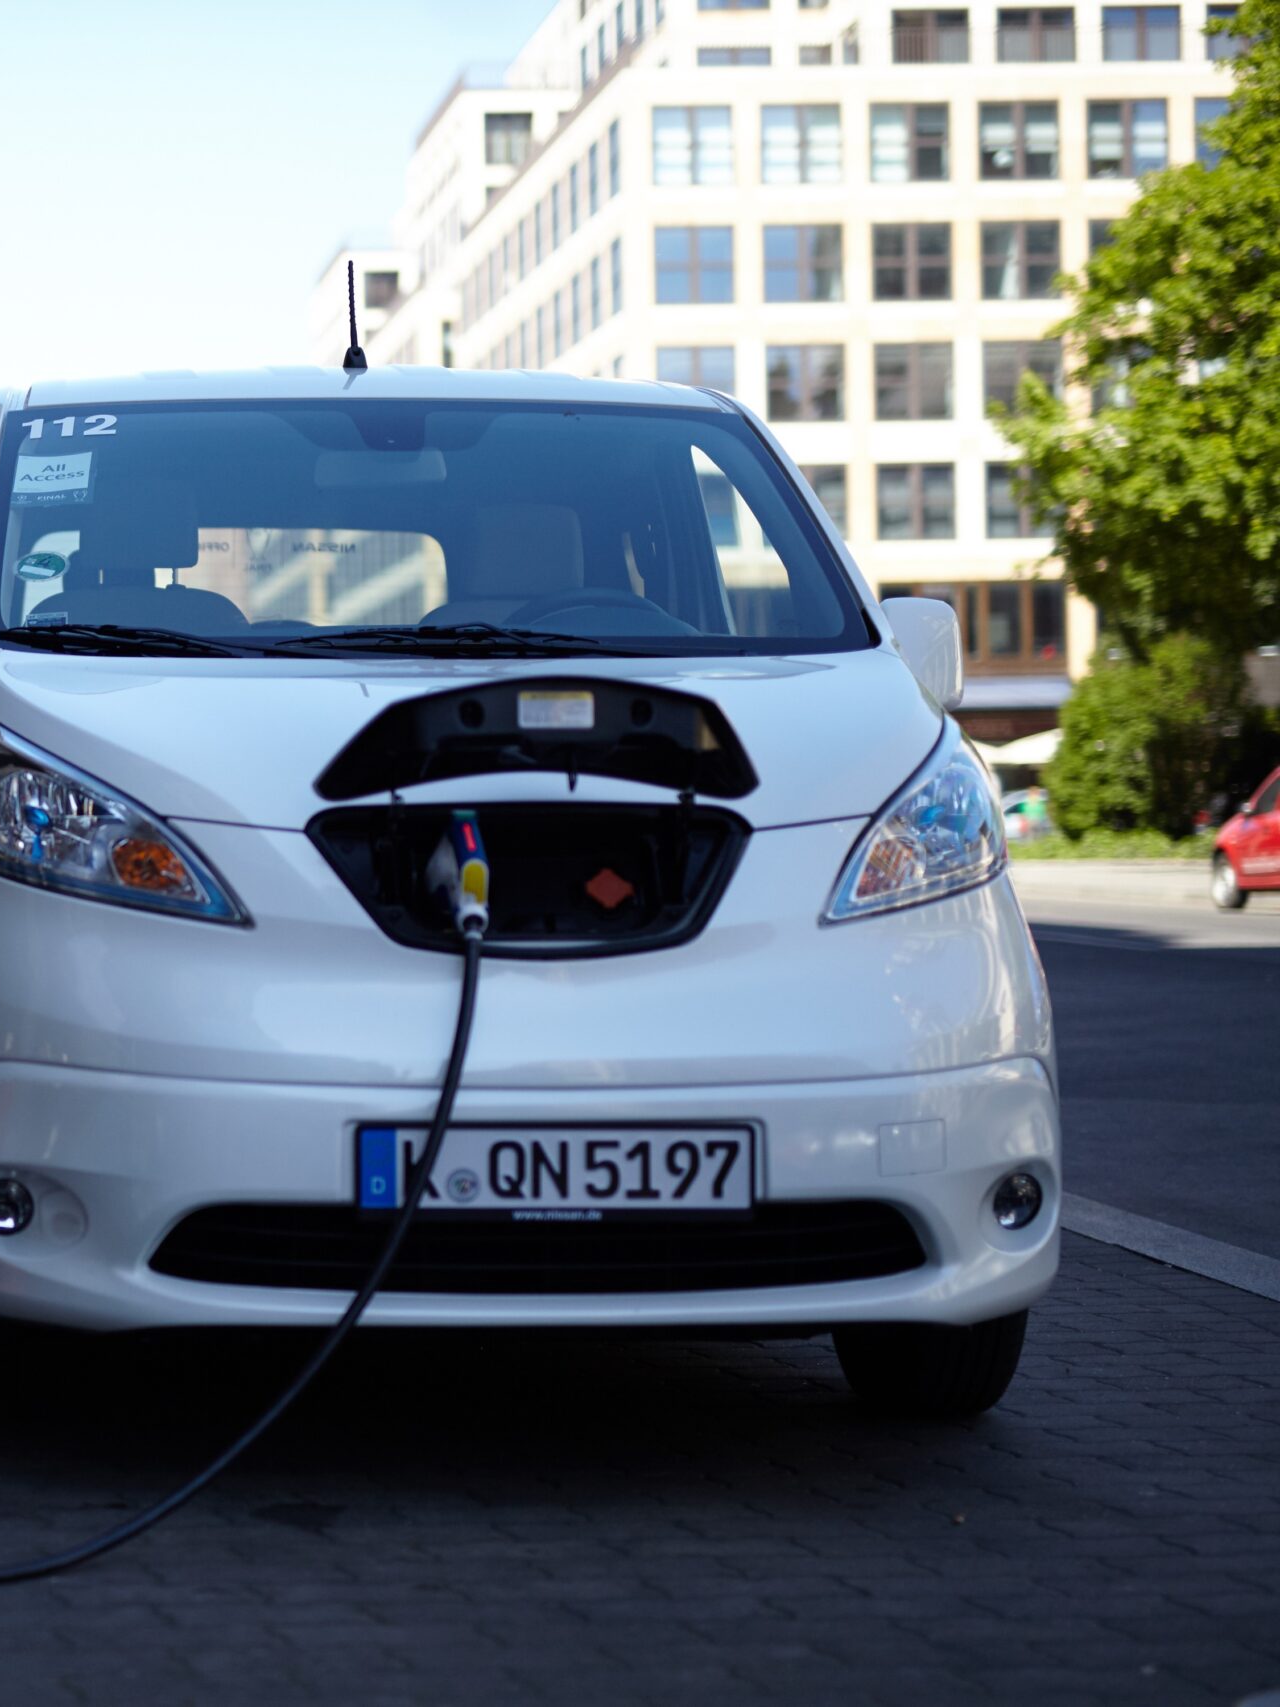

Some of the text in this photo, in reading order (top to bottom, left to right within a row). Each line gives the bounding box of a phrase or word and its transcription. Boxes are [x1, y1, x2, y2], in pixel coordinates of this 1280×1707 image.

[22, 414, 118, 439] 112
[41, 463, 66, 473] All
[20, 470, 85, 482] Access
[370, 1176, 387, 1195] D
